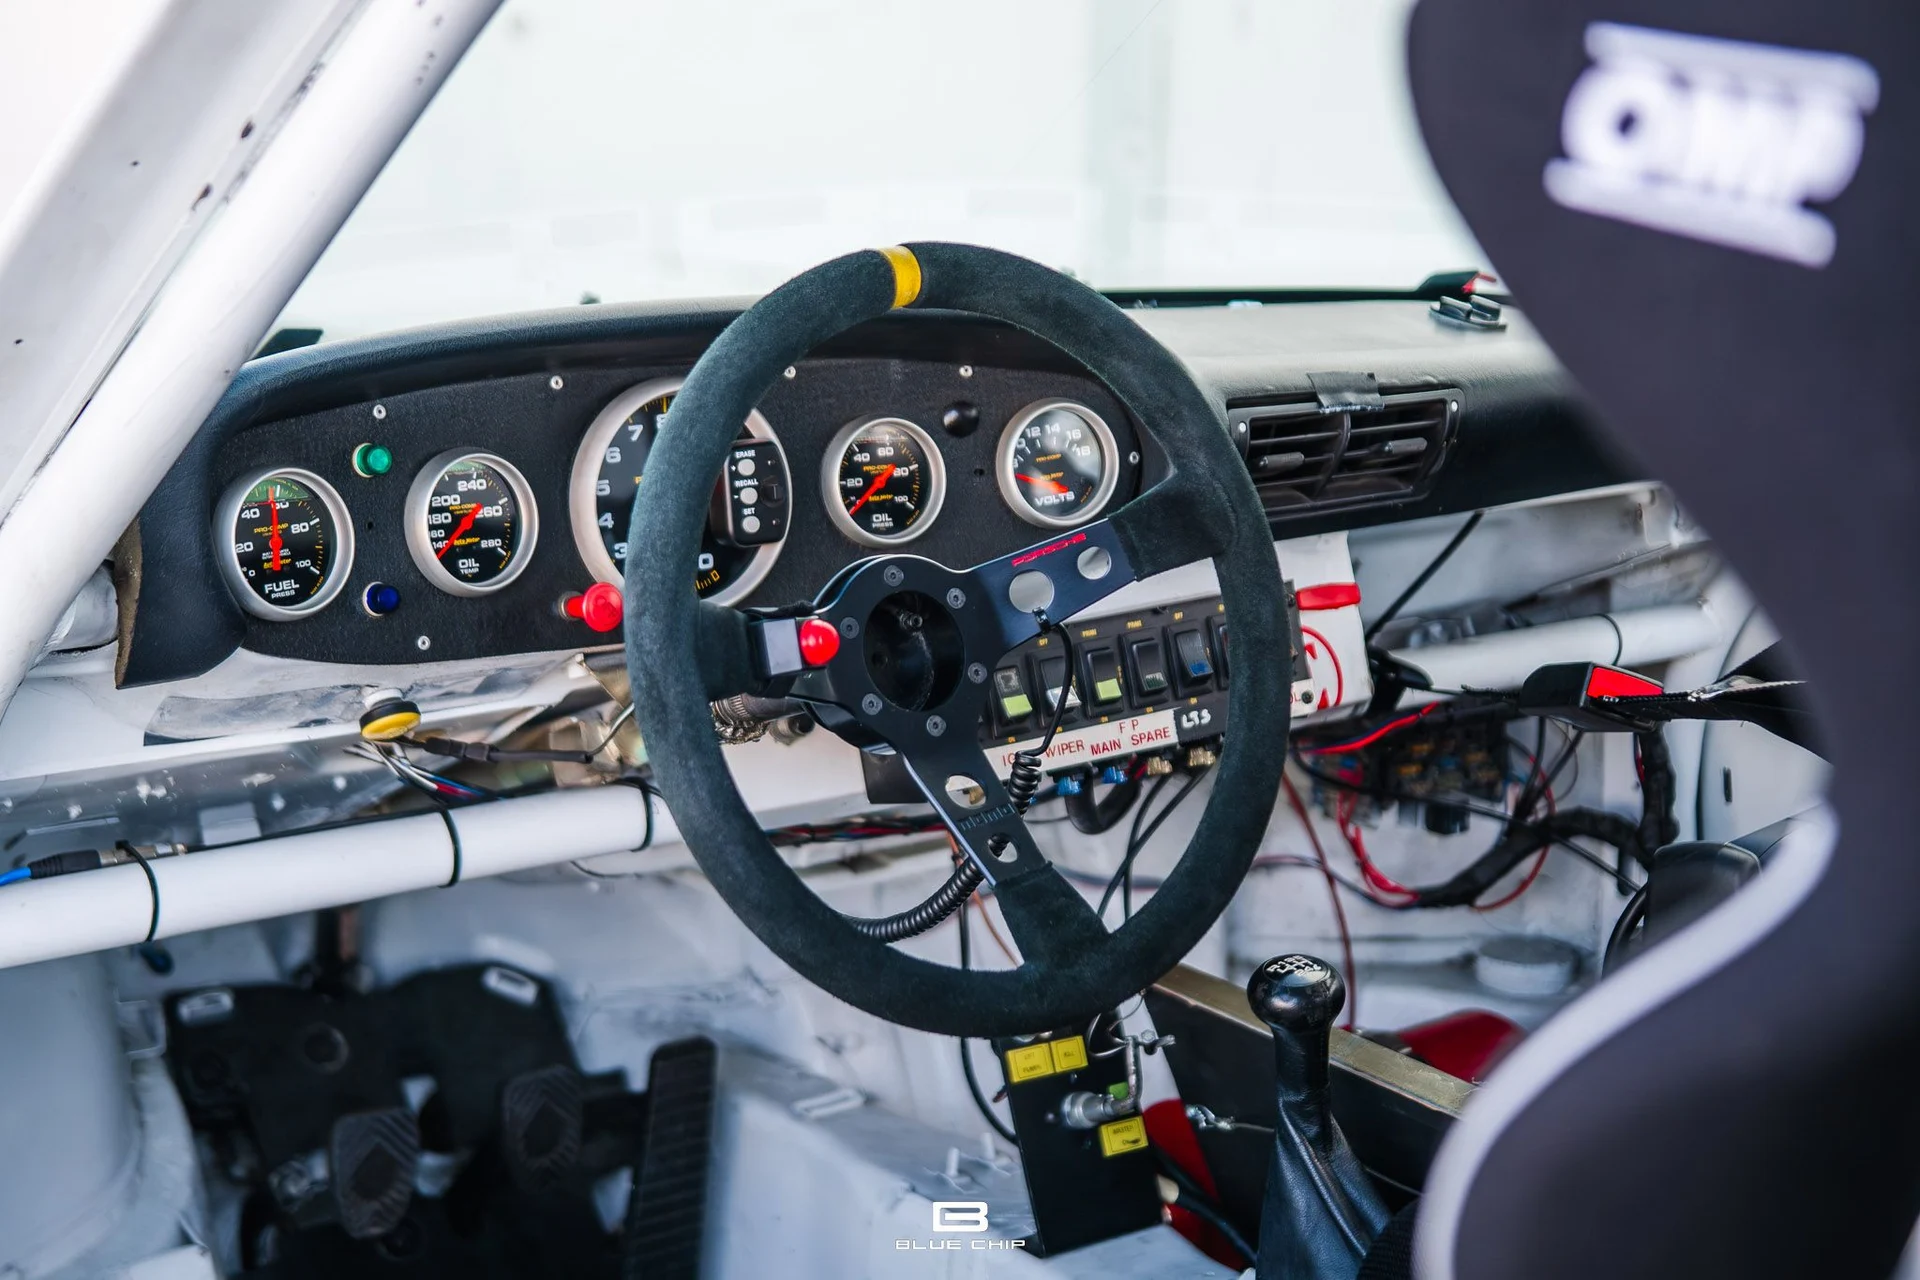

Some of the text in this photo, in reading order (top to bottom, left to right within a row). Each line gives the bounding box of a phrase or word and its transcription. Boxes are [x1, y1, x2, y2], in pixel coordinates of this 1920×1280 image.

[628, 424, 643, 441] 7
[1016, 438, 1026, 449] 0
[1025, 423, 1091, 456] 12 14 16 18
[606, 447, 621, 463] 6
[736, 449, 756, 458] ERASE
[853, 453, 870, 462] 40
[877, 447, 894, 457] 60
[893, 467, 909, 477] 80
[457, 479, 487, 491] 240
[596, 479, 610, 496] 5
[735, 478, 758, 488] RECALL
[847, 478, 863, 487] 20
[432, 494, 461, 507] 200
[894, 495, 909, 503] 100
[1035, 491, 1075, 506] VOLTS
[241, 508, 260, 519] 40
[743, 507, 756, 515] SET
[428, 512, 452, 525] 180
[599, 512, 614, 528] 4
[872, 513, 892, 522] OIL
[291, 522, 309, 534] 80
[235, 541, 254, 553] 20
[481, 539, 502, 549] 280
[614, 542, 628, 559] 3
[295, 560, 311, 569] 100
[459, 558, 480, 569] OIL
[698, 553, 714, 569] 0
[460, 567, 480, 575] TEMP
[264, 579, 300, 593] FUEL
[271, 589, 296, 599] PRESS
[1045, 740, 1085, 758] WIPER
[1091, 737, 1121, 757] MAIN
[1131, 727, 1170, 746] SPARE
